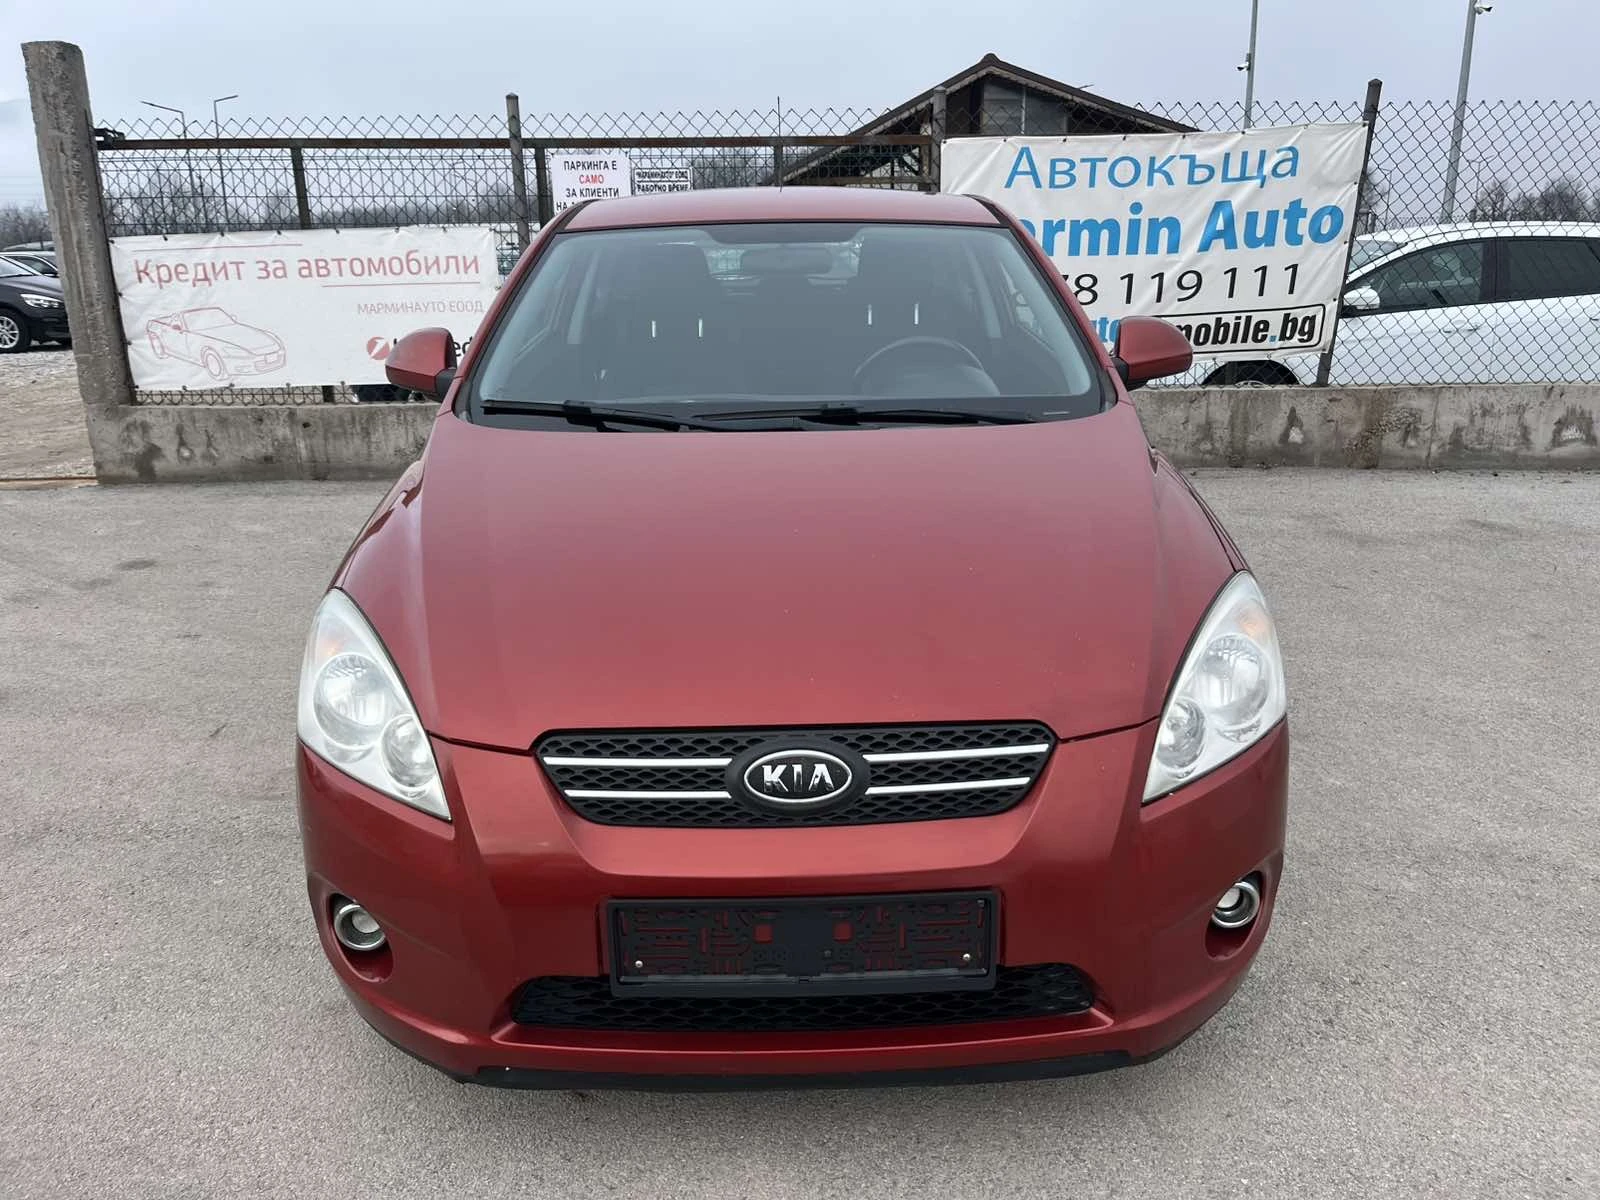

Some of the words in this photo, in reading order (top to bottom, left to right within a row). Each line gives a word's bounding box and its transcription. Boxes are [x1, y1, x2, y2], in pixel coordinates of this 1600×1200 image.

[564, 160, 609, 171] ПАРКИНГА
[611, 160, 617, 170] Е
[1004, 145, 1300, 188] Автокъща
[579, 174, 604, 184] САМО
[637, 184, 667, 192] РАБОТНО
[565, 187, 577, 198] ЗА
[579, 187, 619, 198] КЛИЕНТИ
[1197, 198, 1344, 252] Auto
[134, 258, 245, 289] Кредит
[256, 258, 288, 280] за
[297, 249, 480, 278] автомобили
[1119, 269, 1204, 305] 119
[1222, 263, 1299, 299] 111
[357, 301, 446, 315] МАРМИНАУТО
[449, 299, 485, 314] ЕООД
[762, 764, 835, 793] KIA
